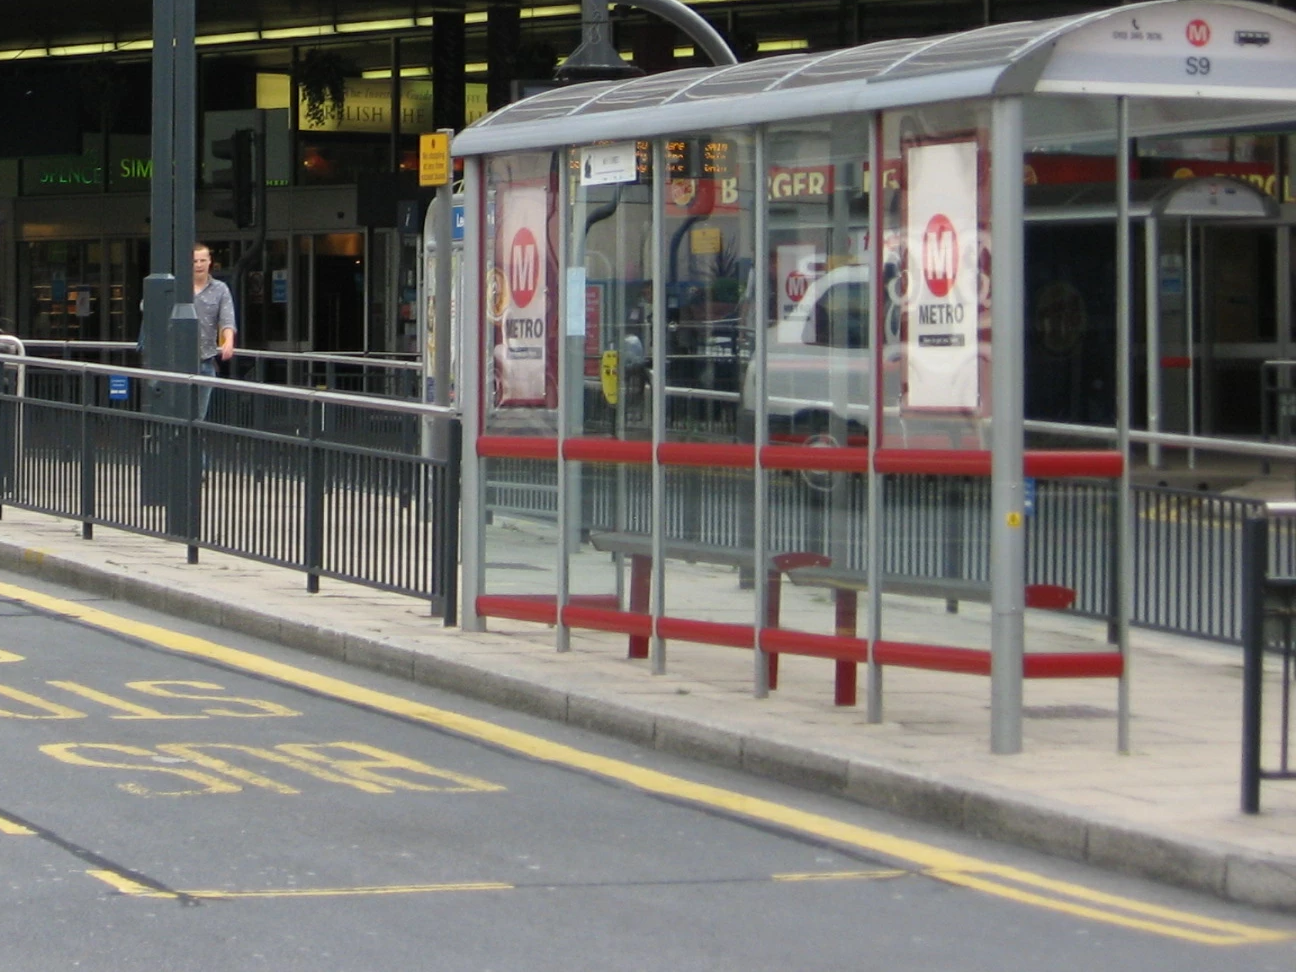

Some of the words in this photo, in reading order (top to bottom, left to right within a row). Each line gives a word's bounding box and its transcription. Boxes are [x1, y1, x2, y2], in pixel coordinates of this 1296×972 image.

[1186, 56, 1211, 75] S9
[513, 245, 535, 292] M
[927, 231, 954, 280] M
[506, 317, 543, 339] METRO
[918, 303, 964, 325] METRO
[39, 741, 508, 797] BUS
